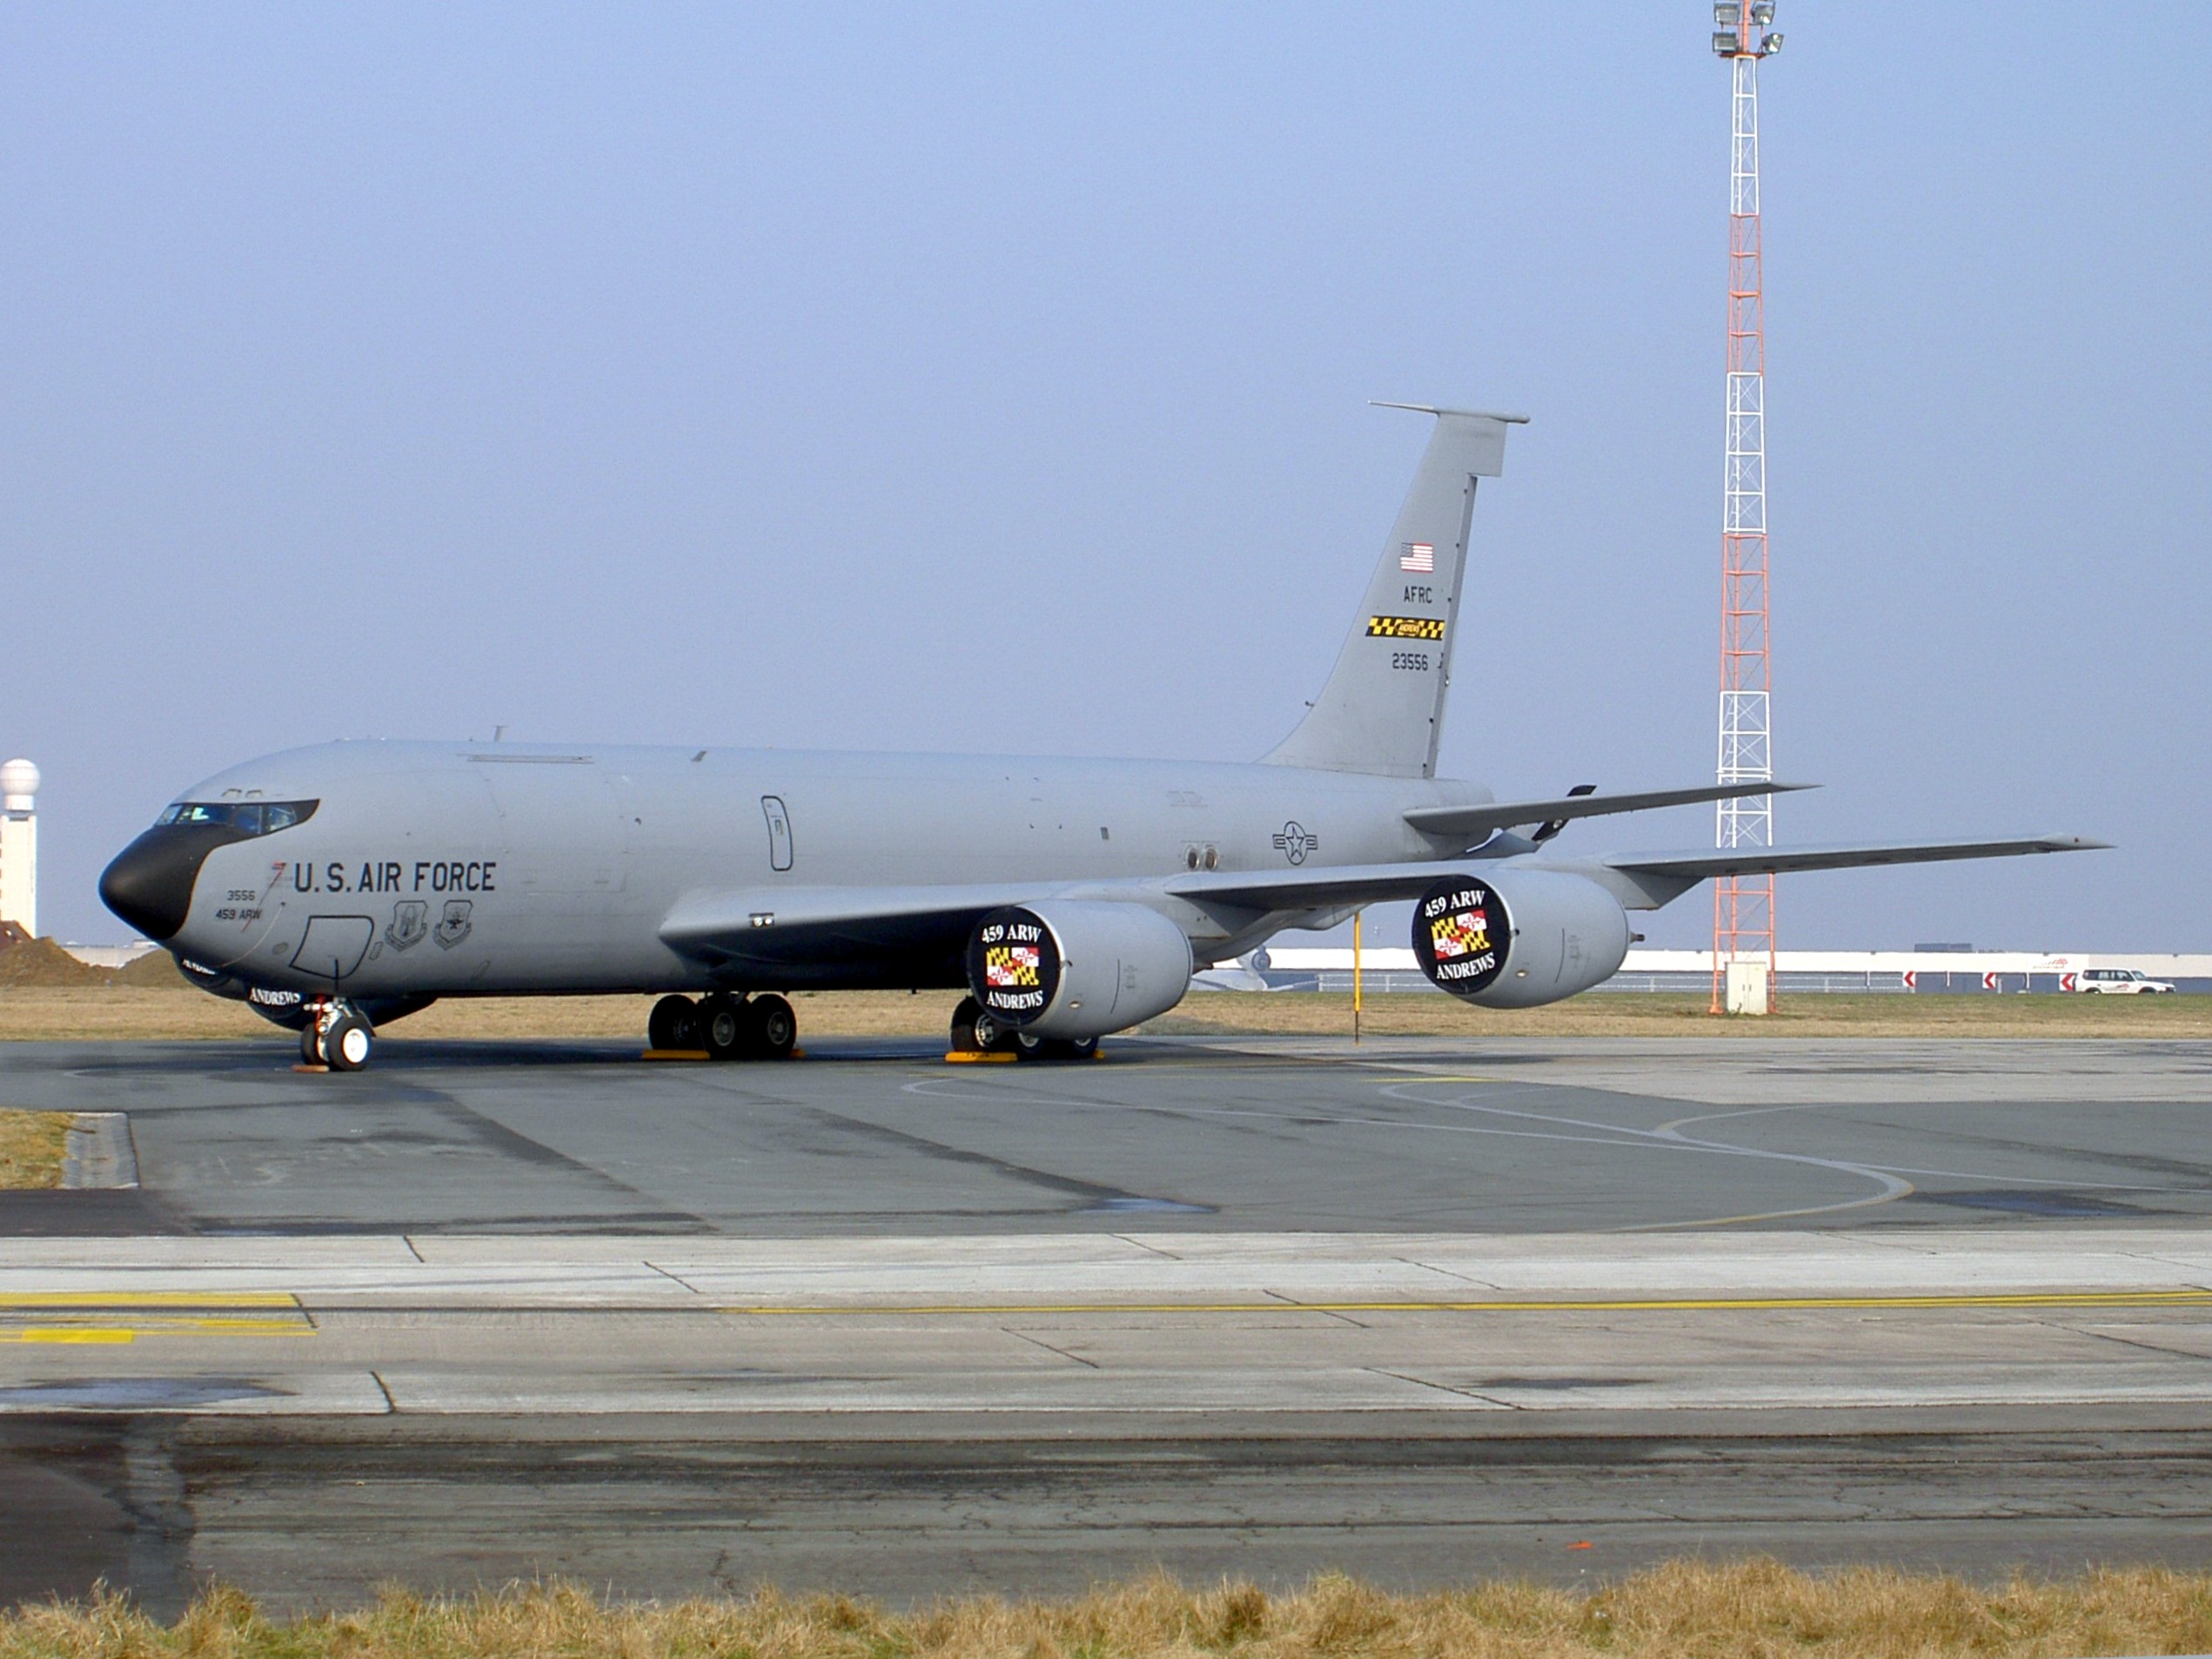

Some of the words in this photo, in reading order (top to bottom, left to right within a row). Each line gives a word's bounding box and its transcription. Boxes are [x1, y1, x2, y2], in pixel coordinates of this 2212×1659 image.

[1403, 585, 1433, 604] AFRC
[1392, 652, 1429, 671] 23556
[413, 862, 497, 892] FORCE
[226, 890, 257, 902] 3556
[1424, 896, 1447, 918] 459
[1449, 890, 1485, 910] ARW
[215, 909, 237, 920] 459
[238, 909, 263, 920] ARW
[982, 924, 1005, 944] 459
[1006, 924, 1042, 944] ARW
[1435, 951, 1497, 980] ANDREWS
[249, 987, 302, 1007] ANDREWS
[986, 990, 1044, 1010] ANDREWS
